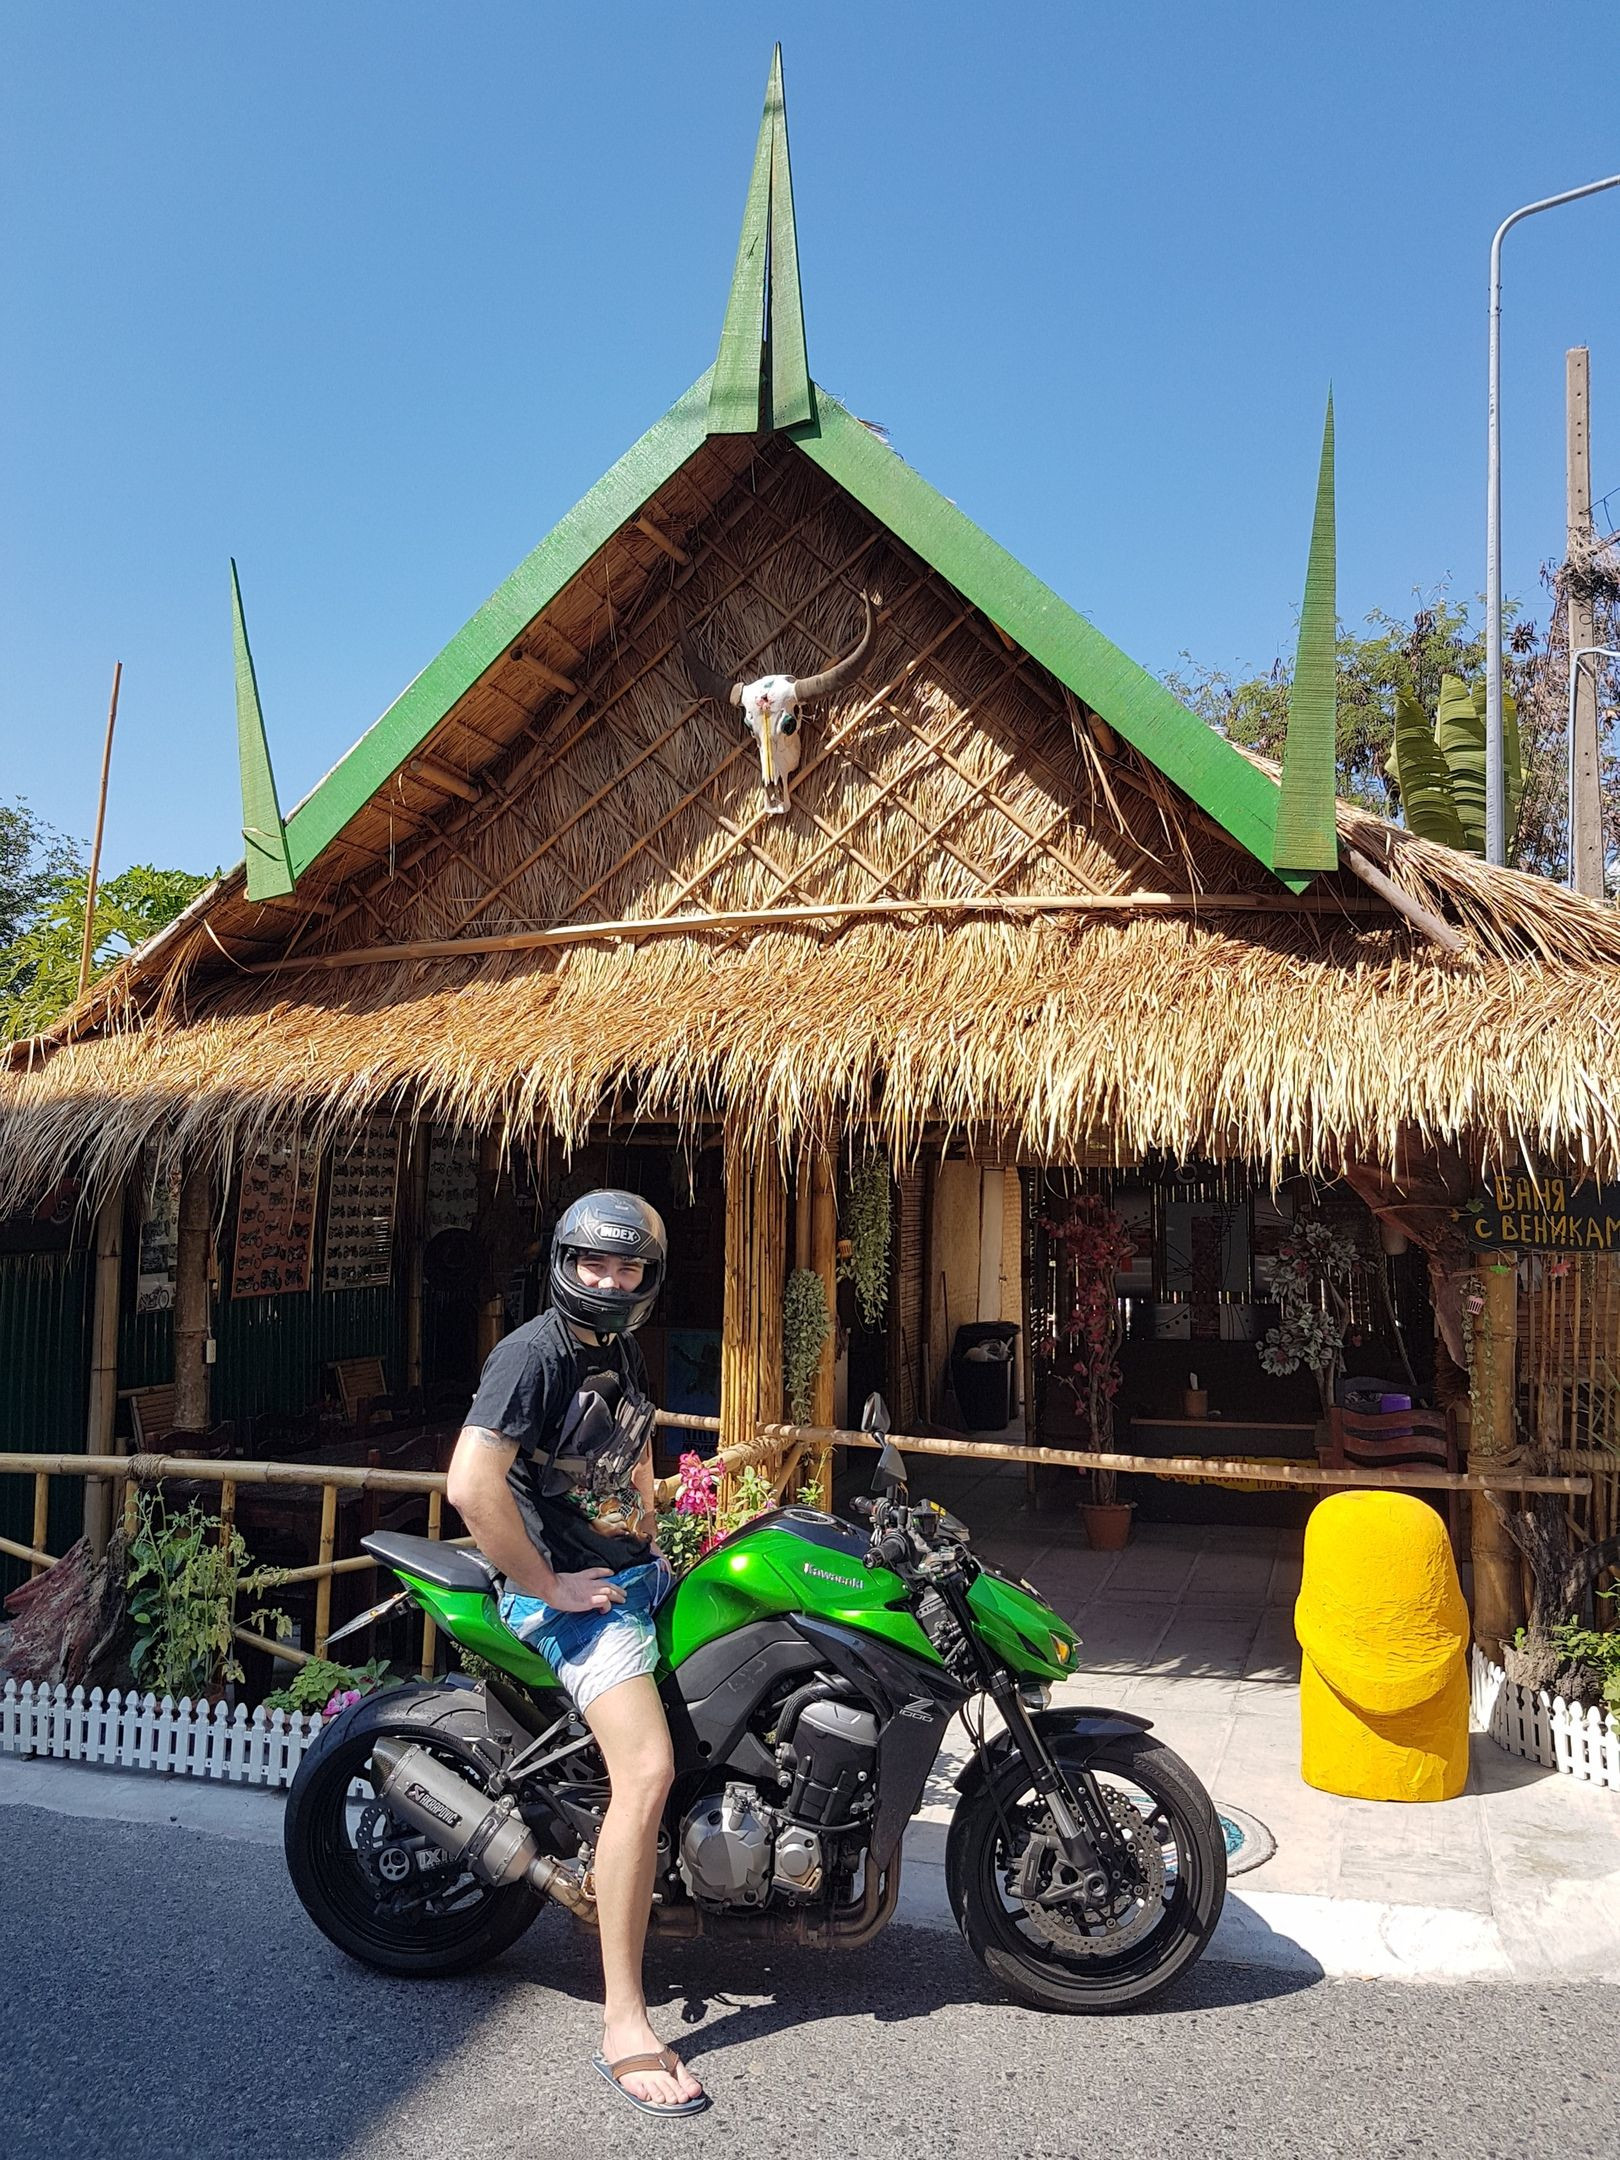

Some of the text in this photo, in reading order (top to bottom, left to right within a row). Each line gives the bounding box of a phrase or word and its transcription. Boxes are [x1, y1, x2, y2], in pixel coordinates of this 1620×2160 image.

[1494, 1175, 1566, 1213] БАНЯ
[600, 1226, 635, 1242] INDEX
[803, 1562, 865, 1590] Kawasaki
[899, 1708, 935, 1723] 1000
[903, 1692, 935, 1717] Z
[418, 1793, 459, 1825] AKRAPOVIC
